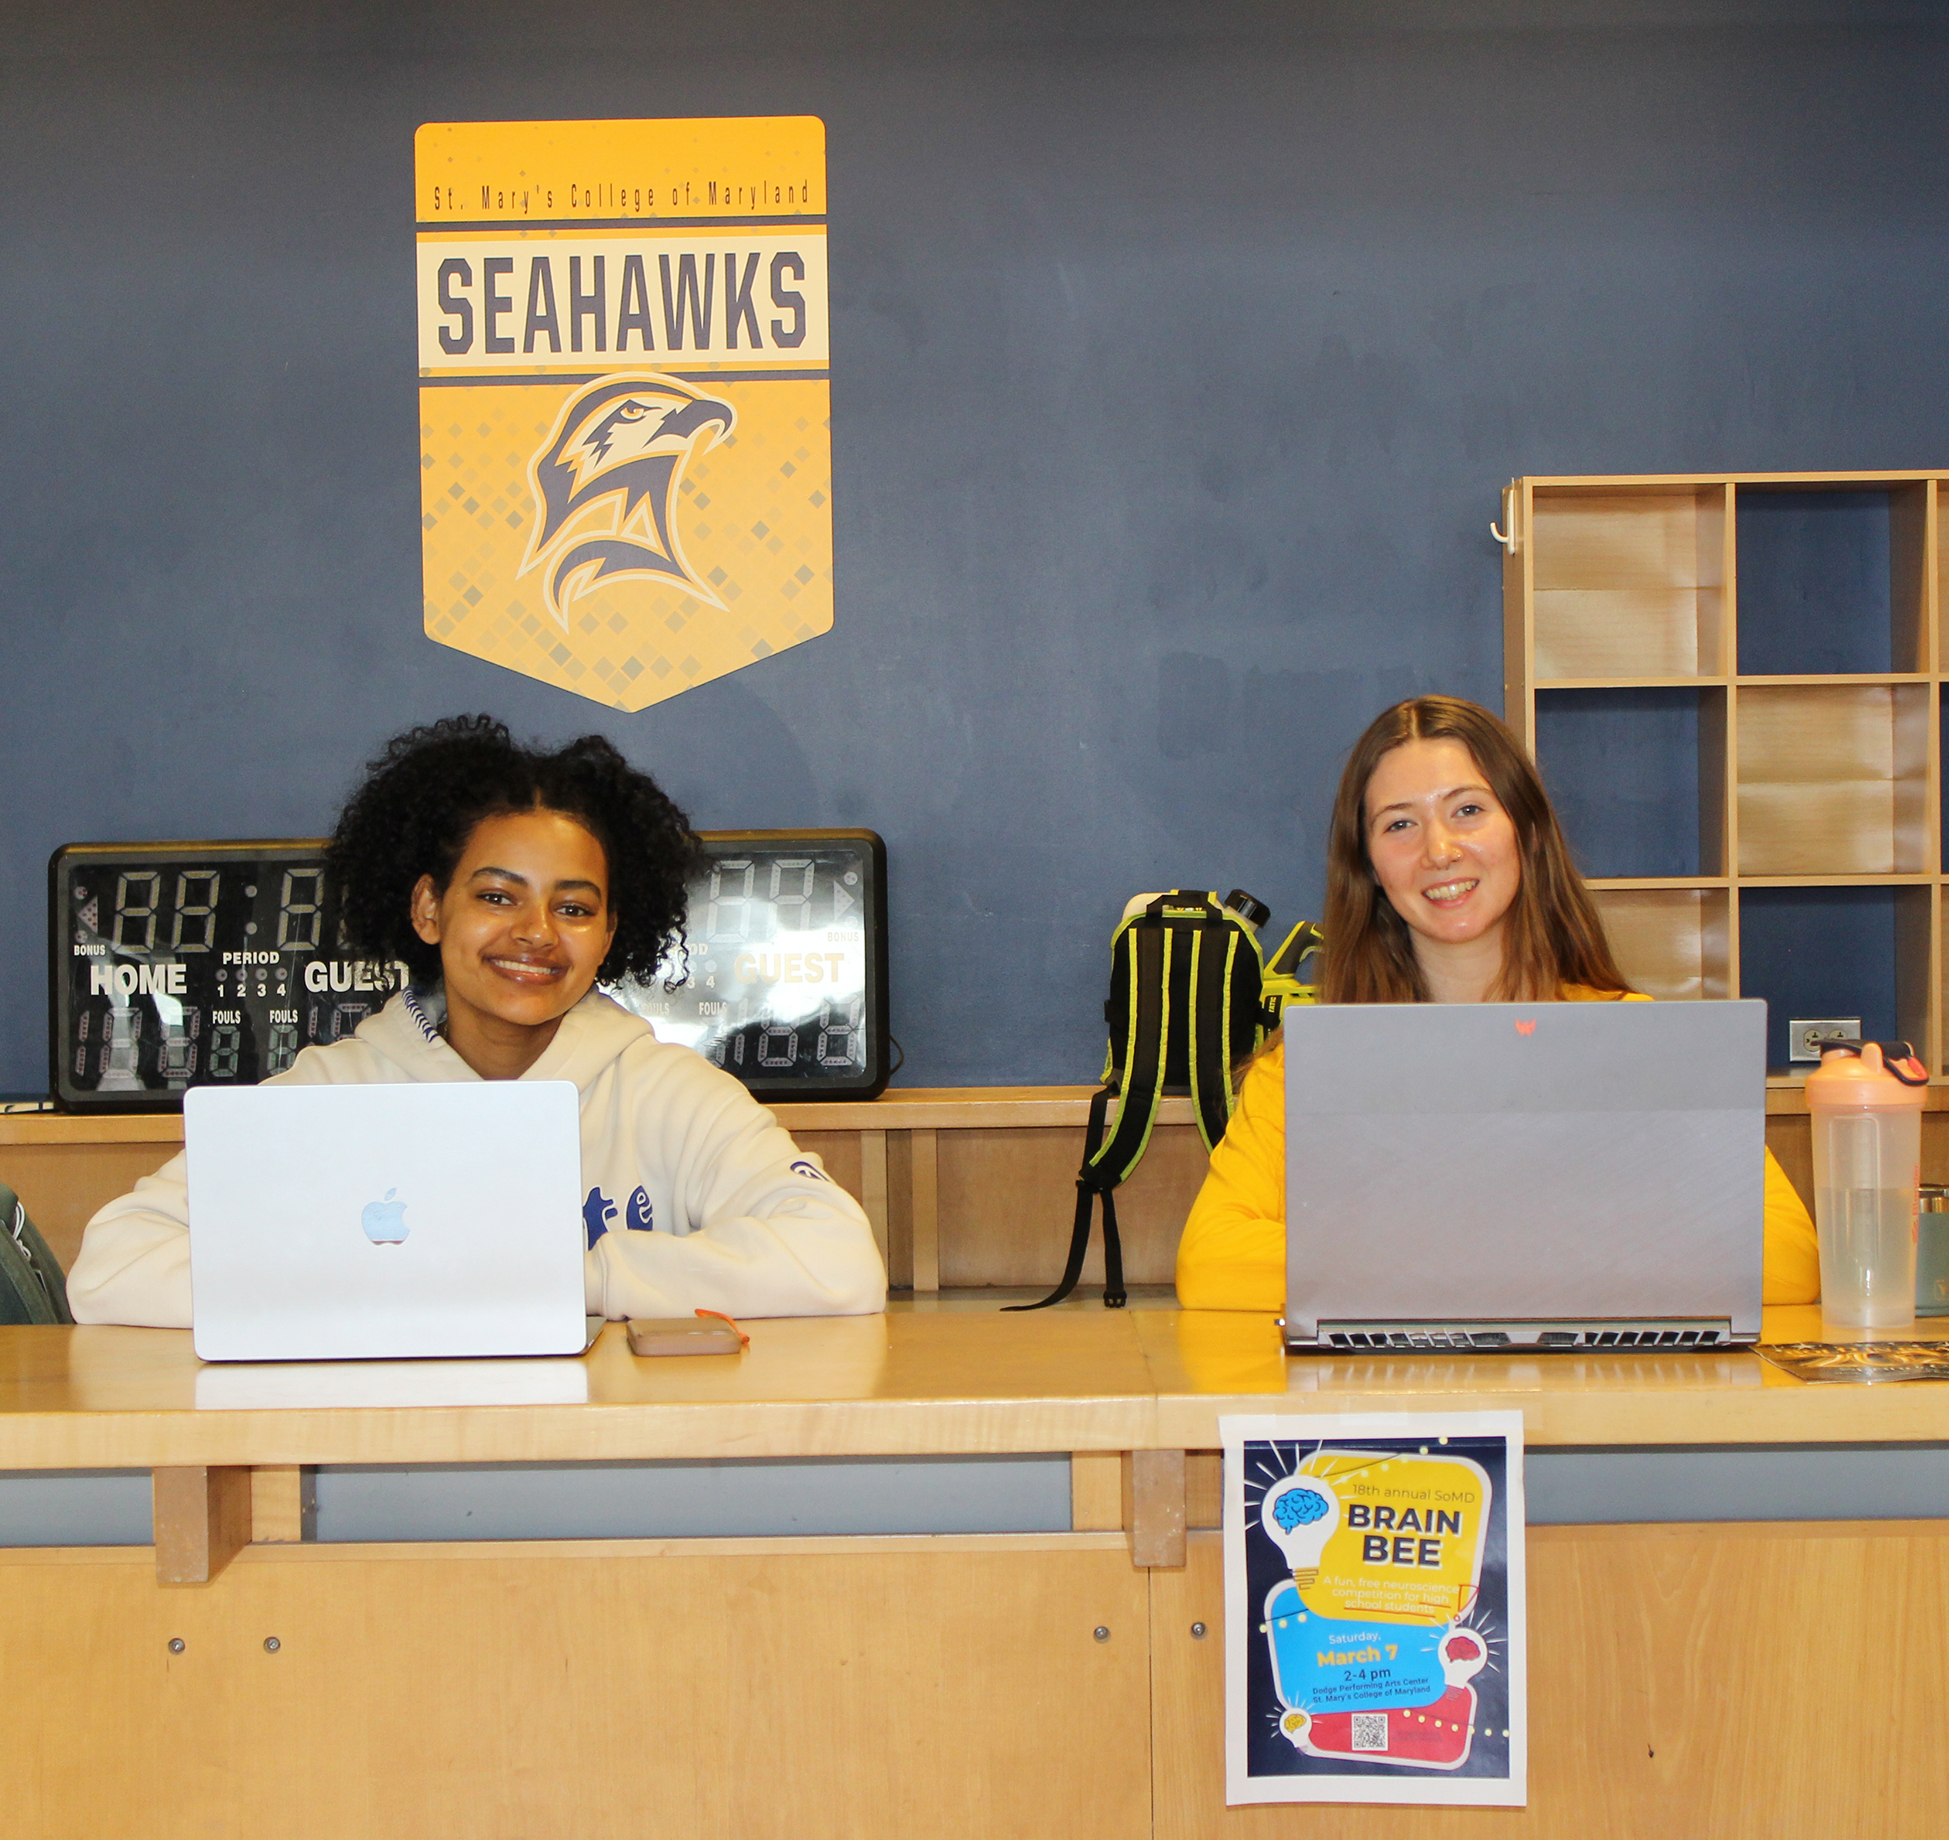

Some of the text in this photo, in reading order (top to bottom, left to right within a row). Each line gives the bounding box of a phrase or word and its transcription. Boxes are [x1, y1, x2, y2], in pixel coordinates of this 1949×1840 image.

[434, 179, 808, 214] St. Mary's College of Maryland
[437, 251, 806, 355] SEAHAWKS
[827, 931, 859, 943] BONUS
[73, 944, 106, 956] BONUS
[222, 951, 280, 965] PERIOD
[304, 960, 410, 993] GUEST
[733, 952, 845, 985] GUEST
[90, 964, 187, 996] HOME
[705, 976, 716, 989] 4
[217, 983, 287, 998] 1 2 3 4
[212, 1010, 241, 1024] FOULS
[269, 1009, 298, 1023] FOULS
[698, 1001, 728, 1016] FOULS
[1352, 1484, 1476, 1504] 18th annual SoMD
[1348, 1504, 1462, 1537] BRAIN
[1362, 1534, 1443, 1569] BEE
[1323, 1576, 1460, 1595] A fun, free neuroscience
[1332, 1588, 1450, 1606] competition for high
[1345, 1599, 1435, 1614] school students
[1317, 1644, 1398, 1668] March 7
[1344, 1668, 1391, 1682] 2-4 pm
[1312, 1678, 1429, 1696] Dodge Performing Arts Center
[1312, 1685, 1431, 1704] St. Mary's College of Maryland
